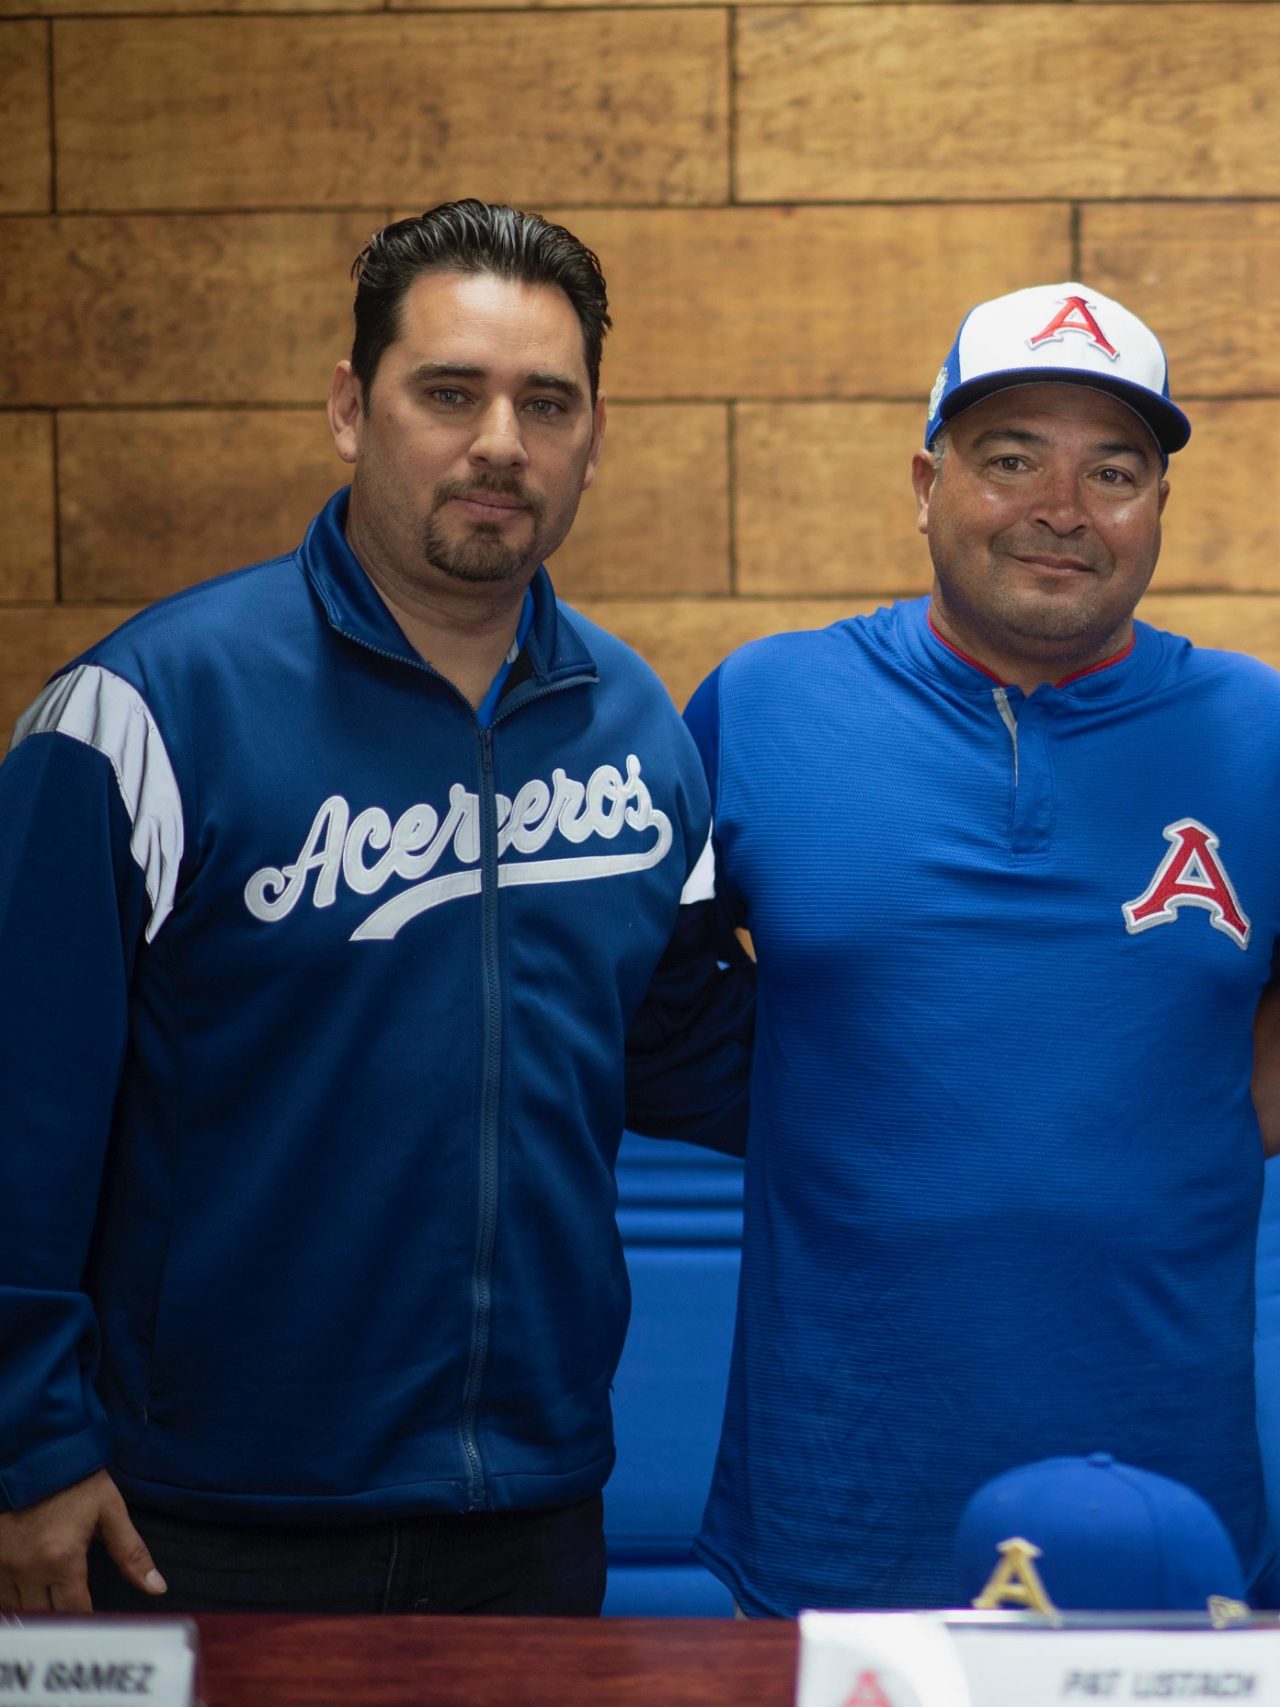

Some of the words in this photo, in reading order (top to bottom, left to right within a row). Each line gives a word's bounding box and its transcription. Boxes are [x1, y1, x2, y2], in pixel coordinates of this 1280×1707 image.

[1025, 295, 1120, 361] A
[244, 754, 673, 941] Acereros
[1122, 817, 1252, 950] A
[971, 1537, 1063, 1629] A
[44, 1660, 155, 1693] GAMEZ
[1063, 1670, 1122, 1698] PAT
